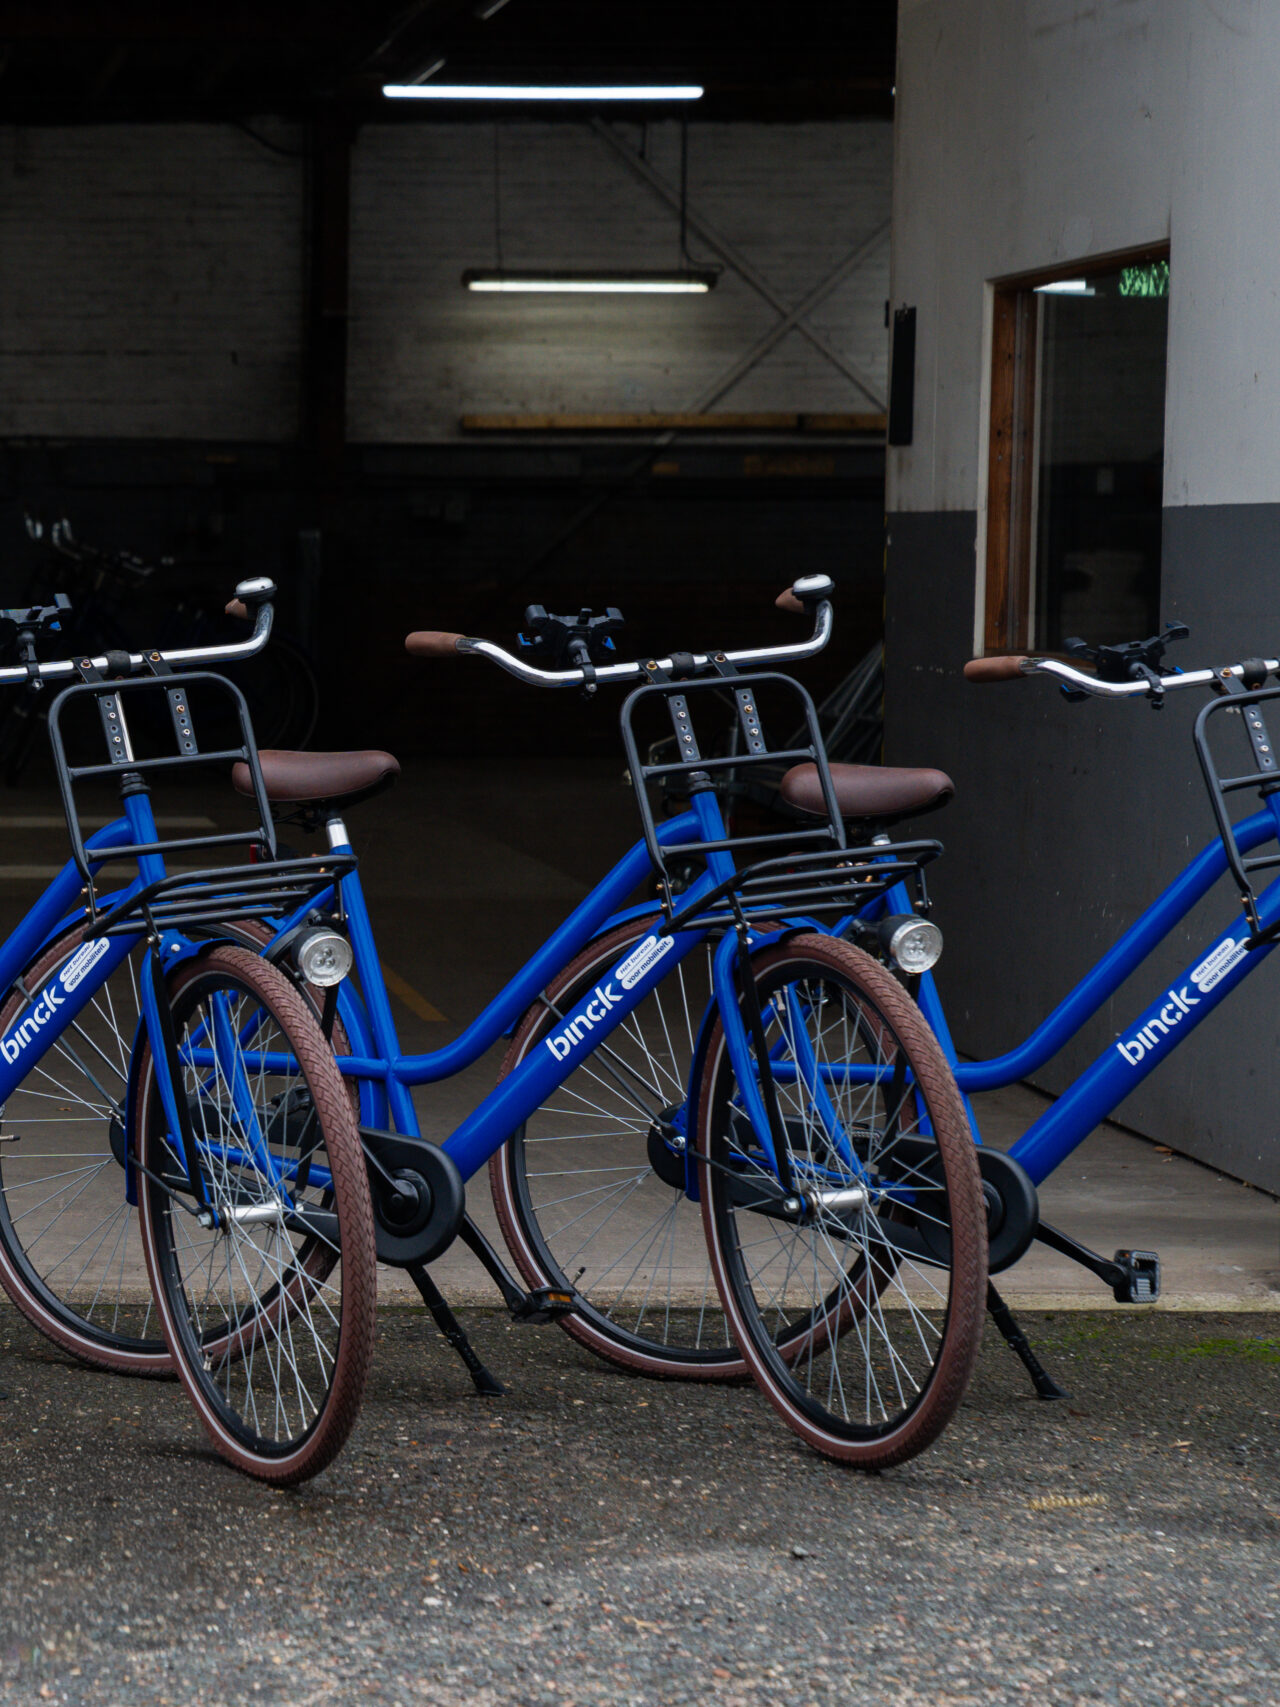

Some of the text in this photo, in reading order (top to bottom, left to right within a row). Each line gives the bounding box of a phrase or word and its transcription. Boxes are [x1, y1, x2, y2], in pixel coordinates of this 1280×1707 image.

[68, 971, 81, 986] voor
[627, 940, 671, 984] voor mobiliteit.
[1204, 972, 1219, 987] voor
[0, 985, 66, 1065] binck
[545, 983, 624, 1062] binck
[1116, 986, 1201, 1066] binck
